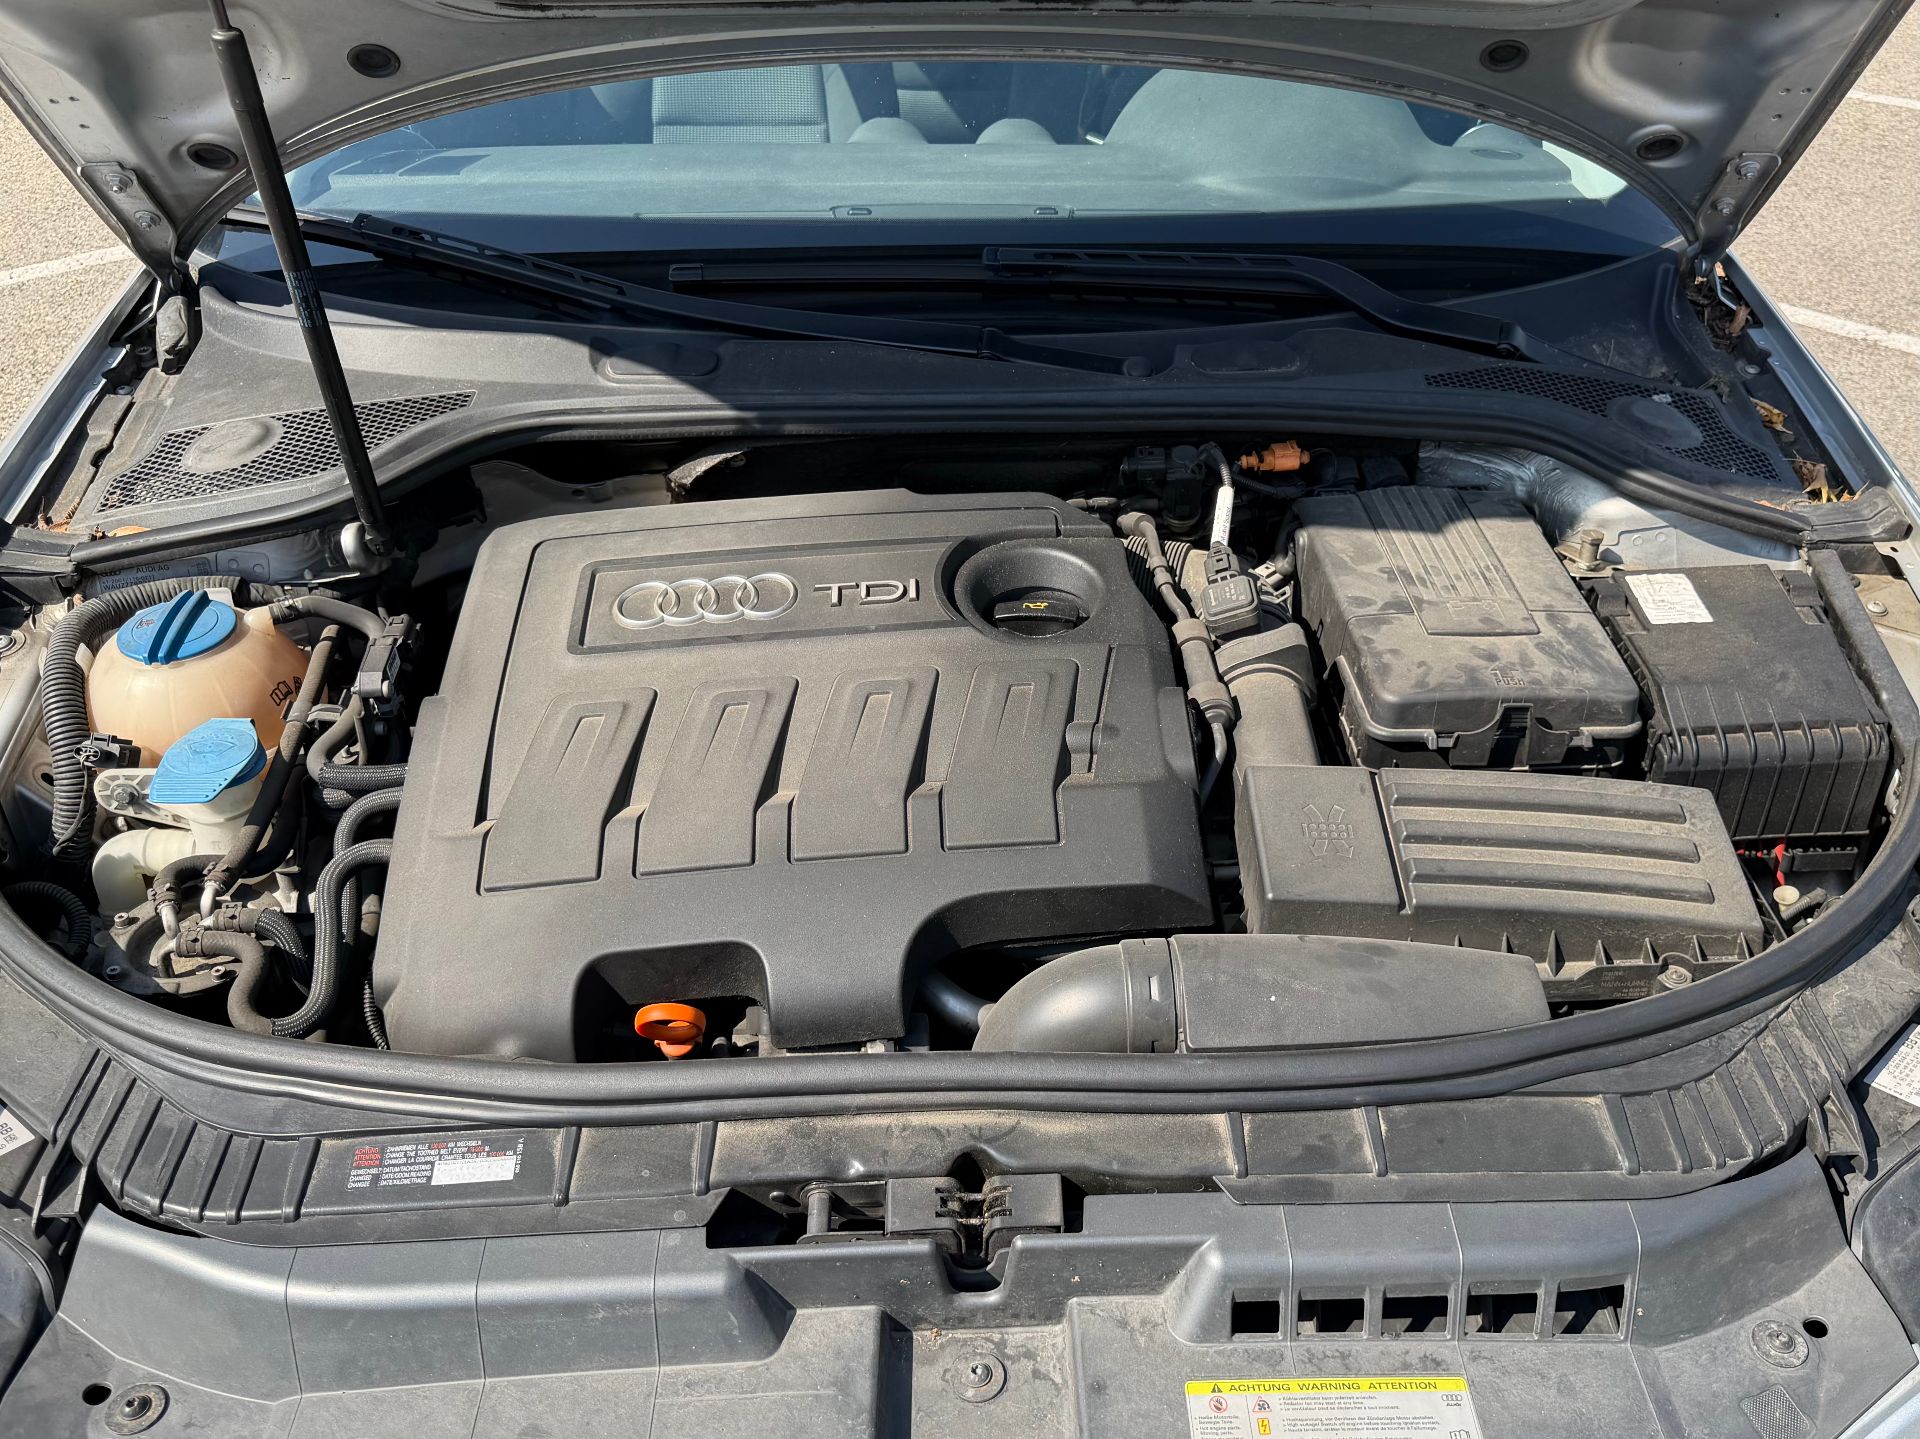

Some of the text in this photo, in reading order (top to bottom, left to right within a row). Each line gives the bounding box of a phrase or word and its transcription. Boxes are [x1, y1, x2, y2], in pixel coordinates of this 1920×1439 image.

[136, 564, 170, 573] AUDI AG
[813, 578, 920, 607] TDI
[1494, 678, 1527, 686] PUSH
[354, 1153, 382, 1161] ATTENTION
[440, 1147, 451, 1155] BELT
[355, 1147, 379, 1155] ACHTUNG
[353, 1159, 380, 1167] ATTENTION
[464, 1152, 477, 1160] TOUS
[1229, 1381, 1438, 1392] ACHTUNG WARNING ATTENTION
